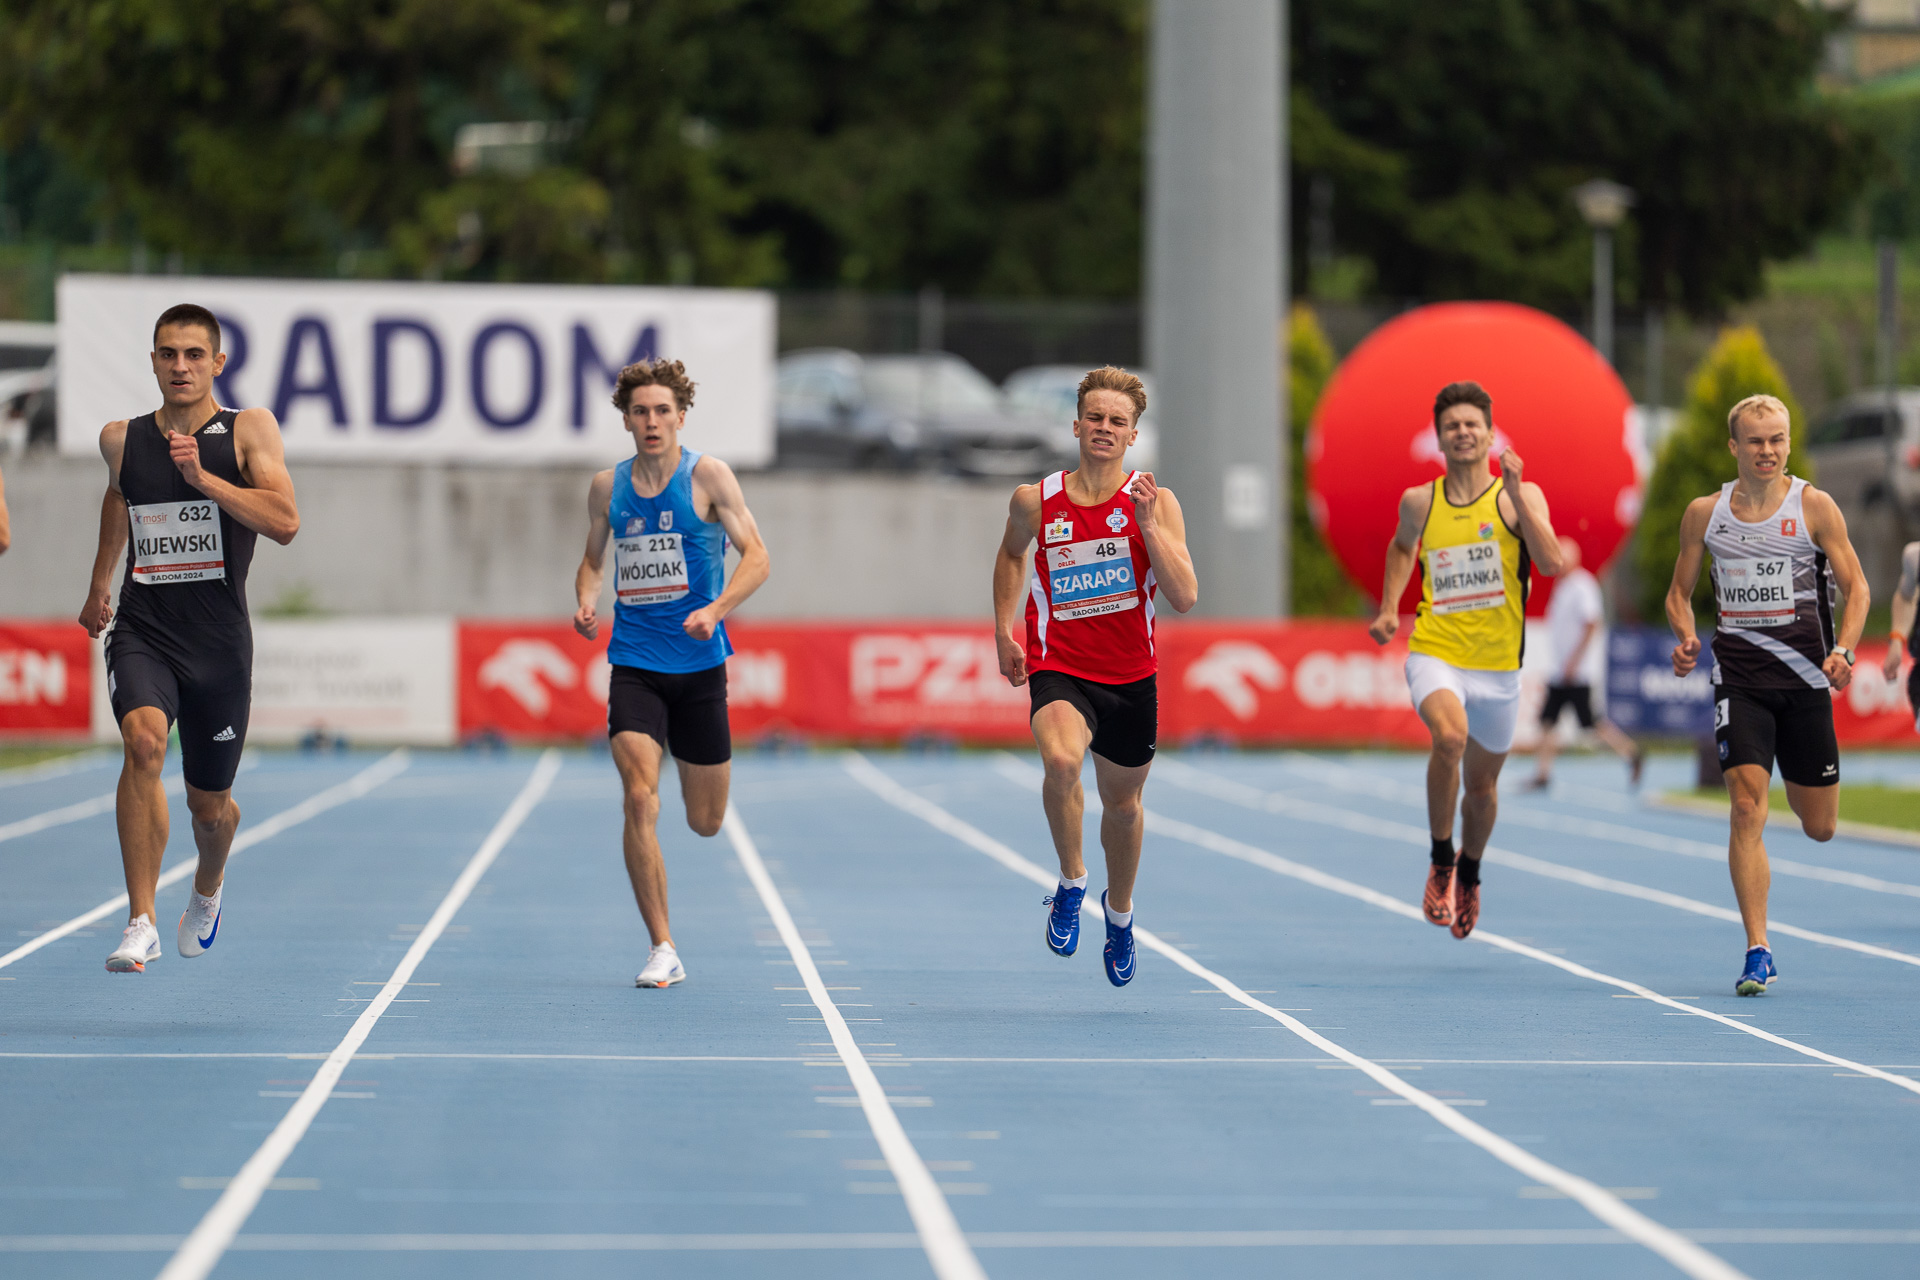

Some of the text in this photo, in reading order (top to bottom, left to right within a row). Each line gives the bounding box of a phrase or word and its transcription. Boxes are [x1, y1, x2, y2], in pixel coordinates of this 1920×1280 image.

[178, 505, 212, 522] 632
[137, 533, 217, 556] KIJEWSKI
[648, 537, 677, 552] 212
[1095, 541, 1117, 557] 48
[1466, 545, 1493, 561] 120
[620, 561, 683, 581] WÓJCIAK
[1057, 559, 1076, 568] ORLEN
[1756, 561, 1785, 576] 567
[151, 571, 204, 582] RADOM 2024
[1053, 566, 1131, 595] SZARAPO
[1723, 584, 1789, 603] WRÓBEL
[1071, 603, 1120, 617] RADOM 2024
